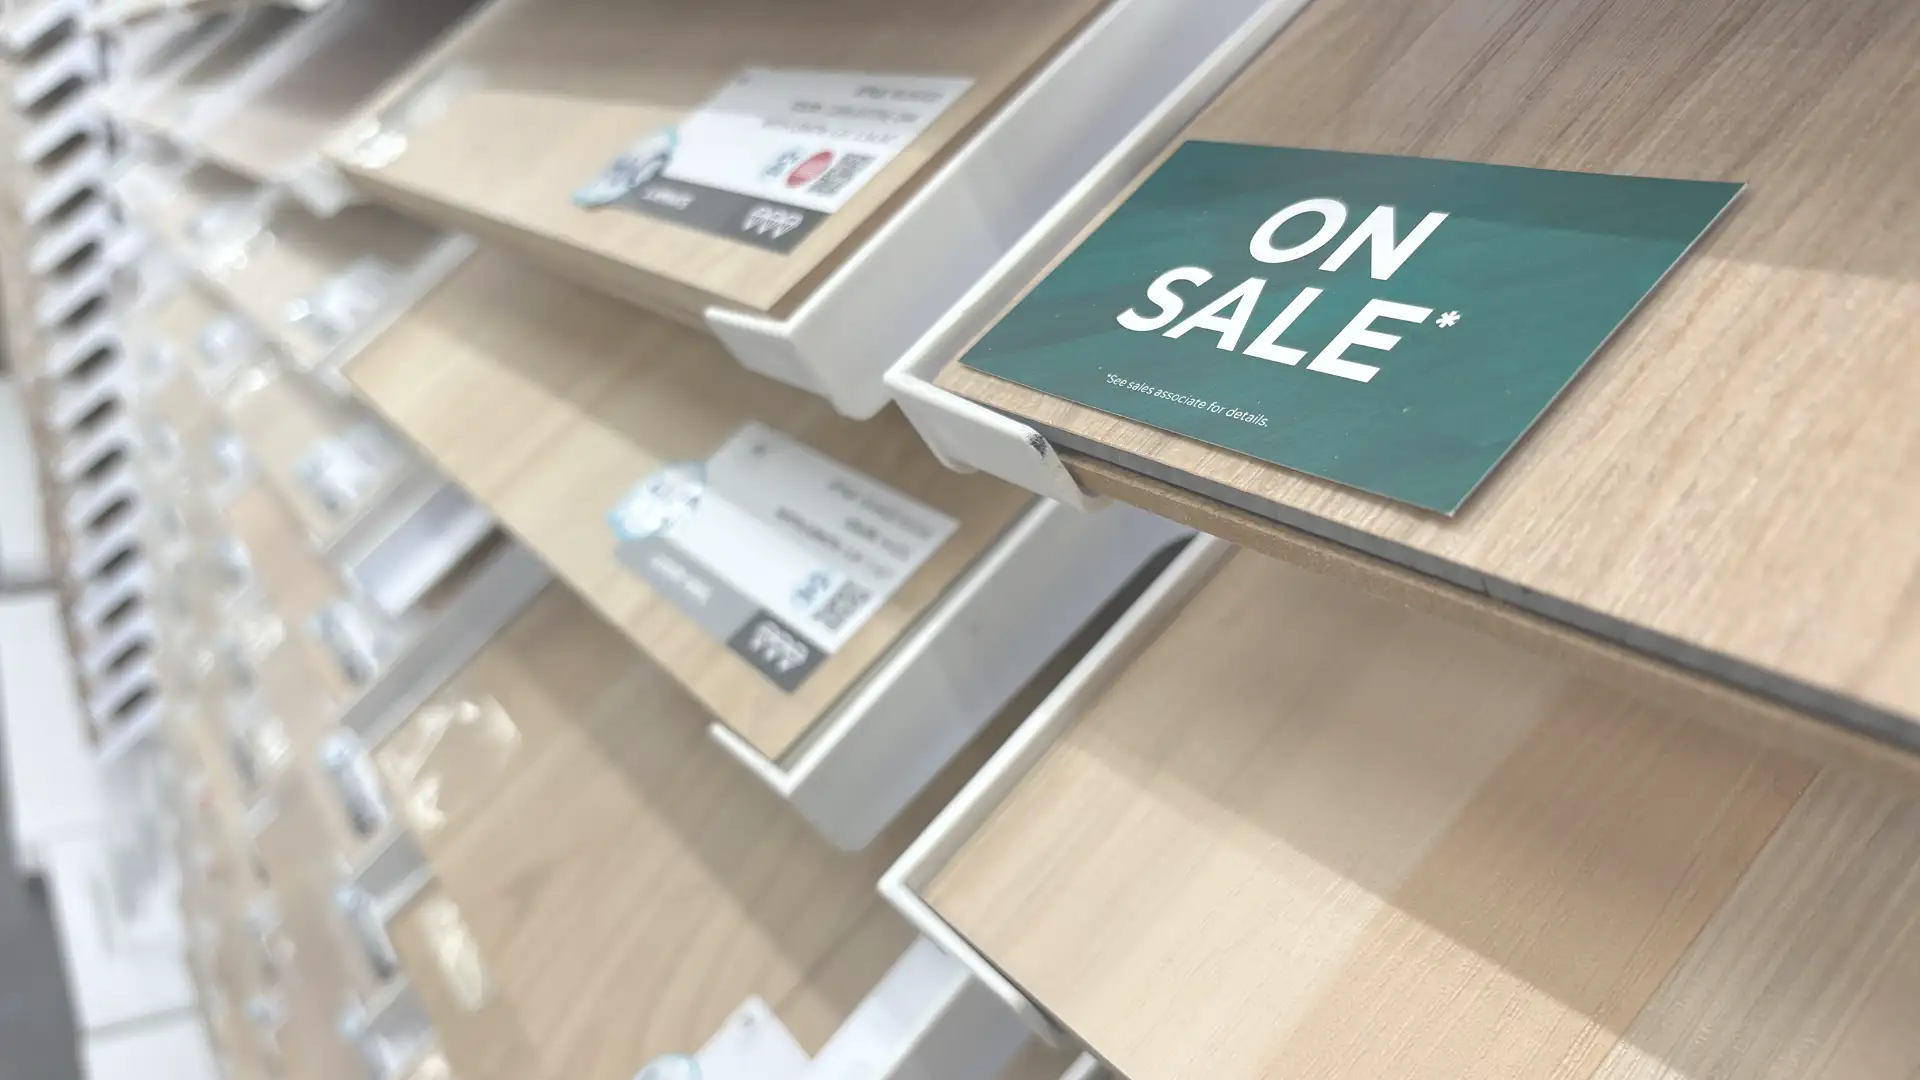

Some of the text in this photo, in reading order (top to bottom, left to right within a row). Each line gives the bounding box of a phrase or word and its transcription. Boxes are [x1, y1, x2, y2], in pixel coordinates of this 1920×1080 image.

[1249, 198, 1449, 281] ON
[1127, 382, 1155, 396] sales
[1154, 389, 1207, 409] associate
[1206, 401, 1226, 415] for
[1225, 407, 1269, 428] details.
